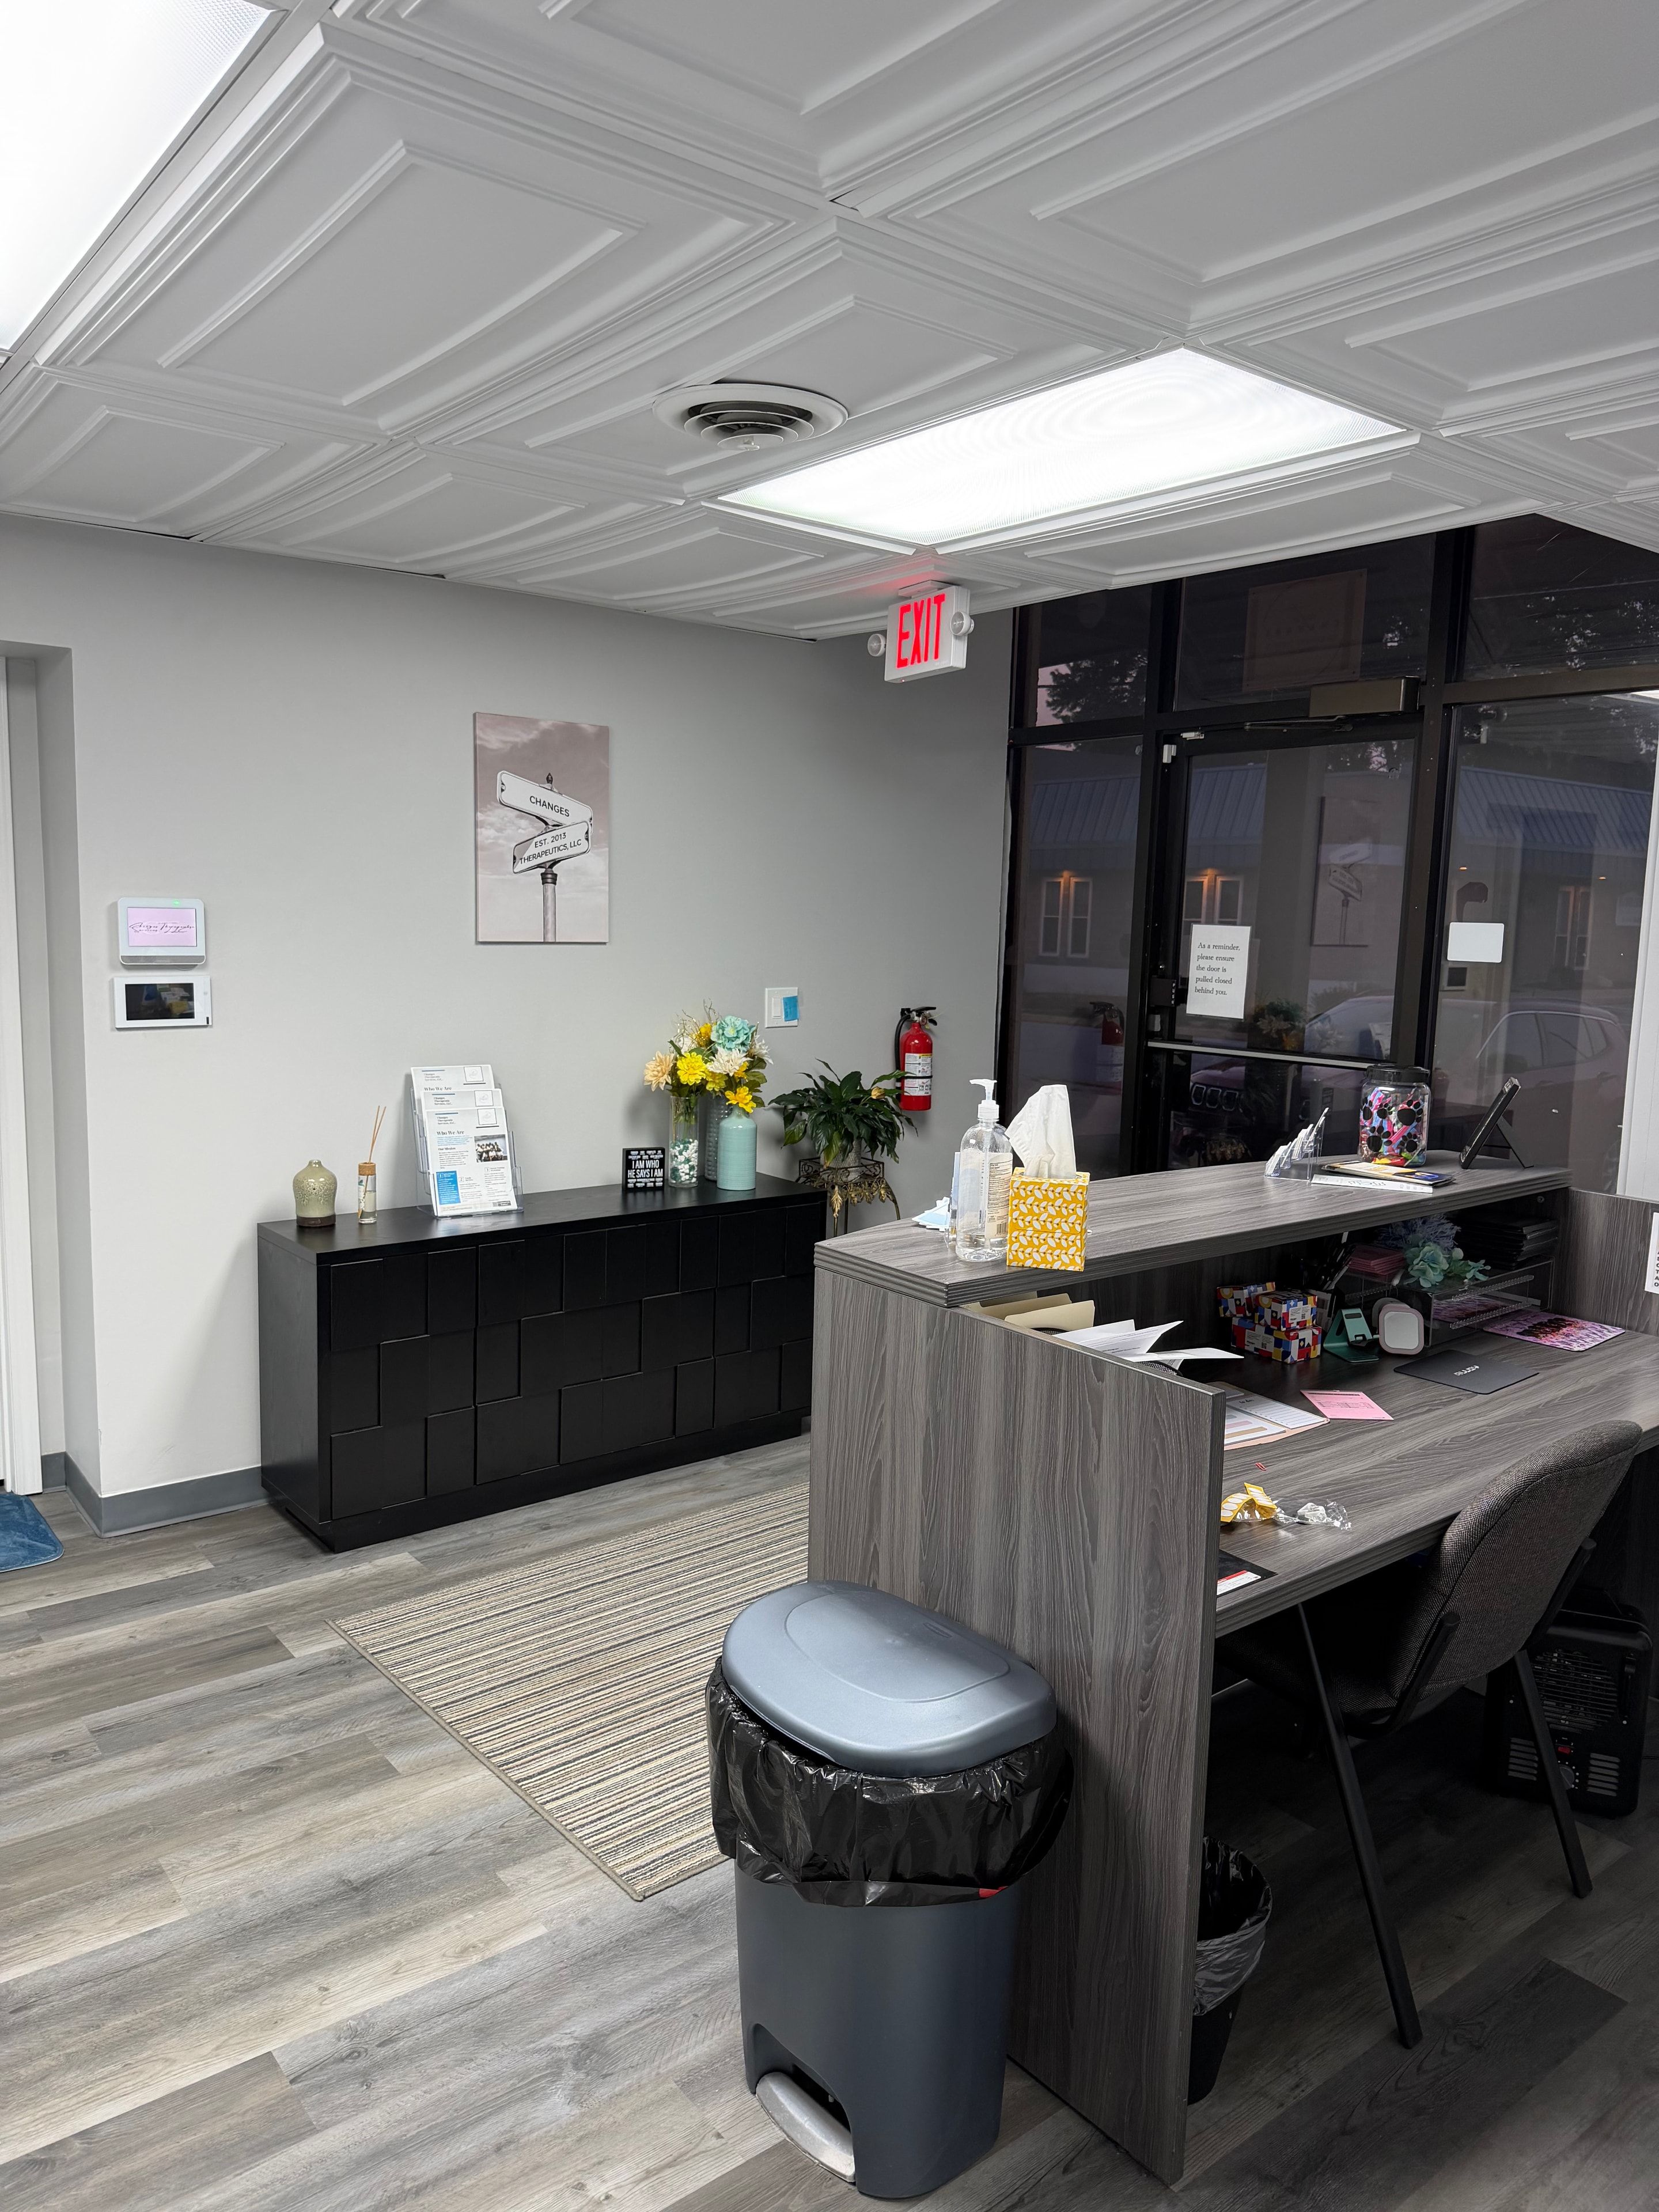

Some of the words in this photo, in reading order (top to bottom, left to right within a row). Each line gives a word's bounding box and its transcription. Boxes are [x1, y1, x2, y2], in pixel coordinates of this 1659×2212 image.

[896, 593, 946, 669] EXIT
[529, 796, 570, 817] CHANGES
[535, 838, 550, 849] EST.
[551, 832, 567, 843] 2013
[520, 843, 569, 865] THERAPEUTICS,
[570, 839, 582, 849] LLC
[1197, 953, 1214, 961] please
[1195, 976, 1213, 984] pulled
[1194, 986, 1214, 994] behind
[635, 1160, 645, 1169] AM
[645, 1159, 660, 1168] WHO
[628, 1169, 635, 1178] HE
[635, 1169, 650, 1178] SAYS
[653, 1168, 663, 1177] AM
